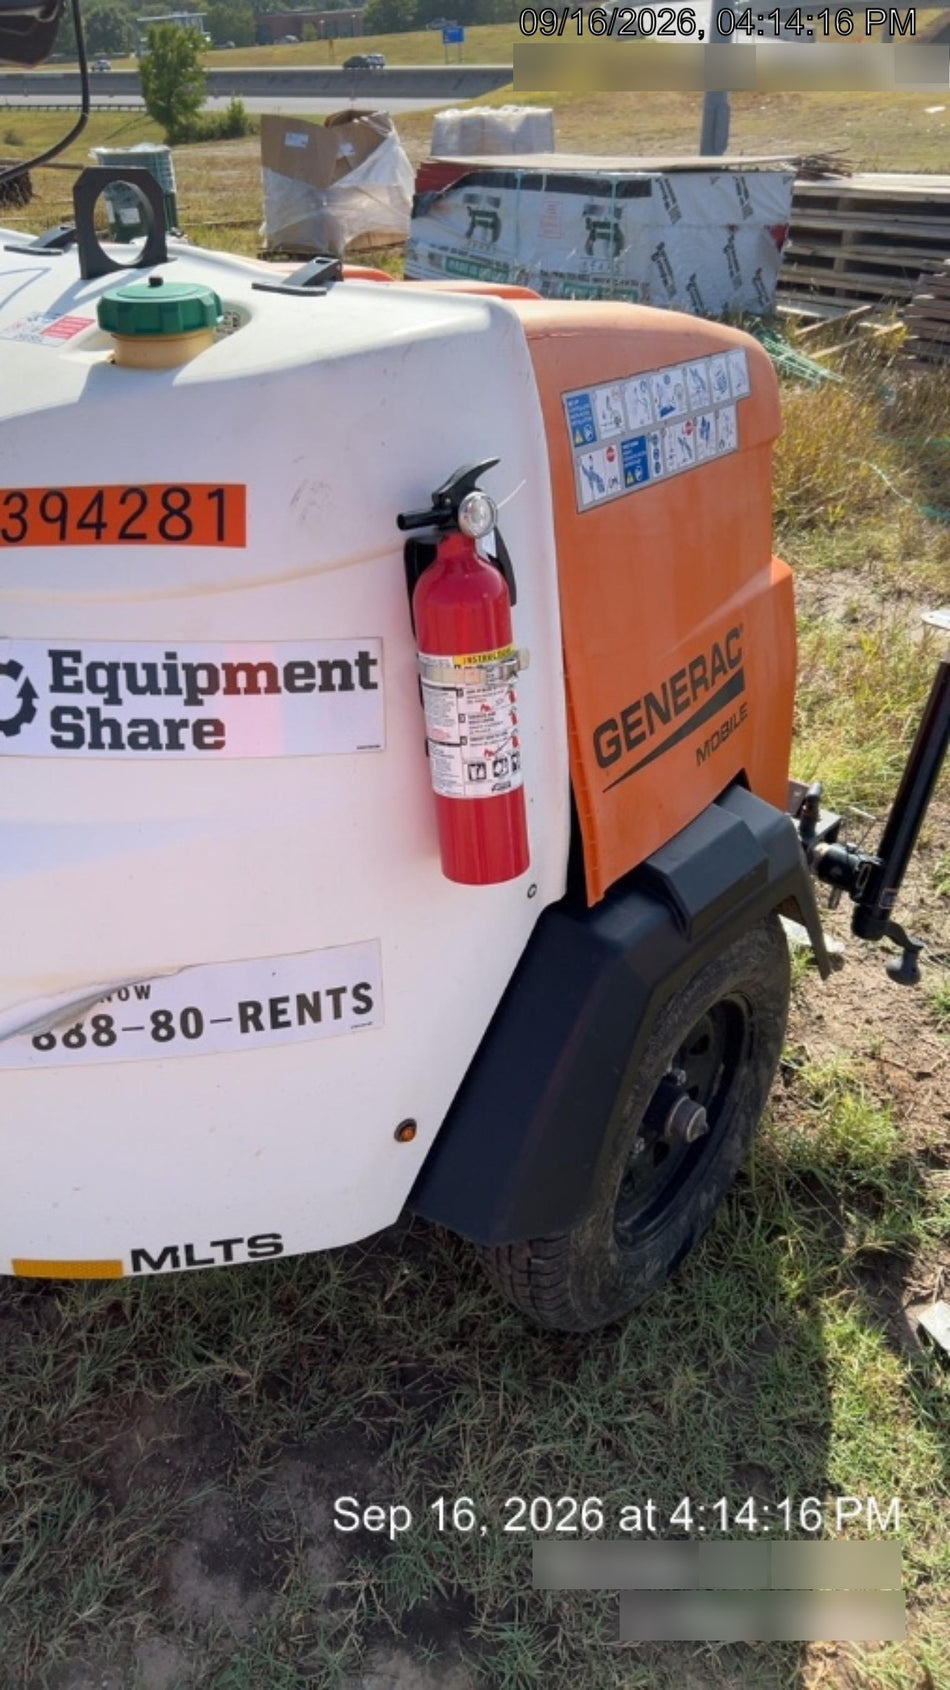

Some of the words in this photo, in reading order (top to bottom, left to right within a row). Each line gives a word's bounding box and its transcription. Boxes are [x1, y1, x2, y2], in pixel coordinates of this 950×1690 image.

[1, 486, 225, 543] 394281
[48, 649, 378, 706] Equipment
[593, 627, 743, 769] GENERAC
[50, 705, 226, 750] Share
[696, 702, 749, 767] MOBILE
[130, 1232, 284, 1273] MLTS
